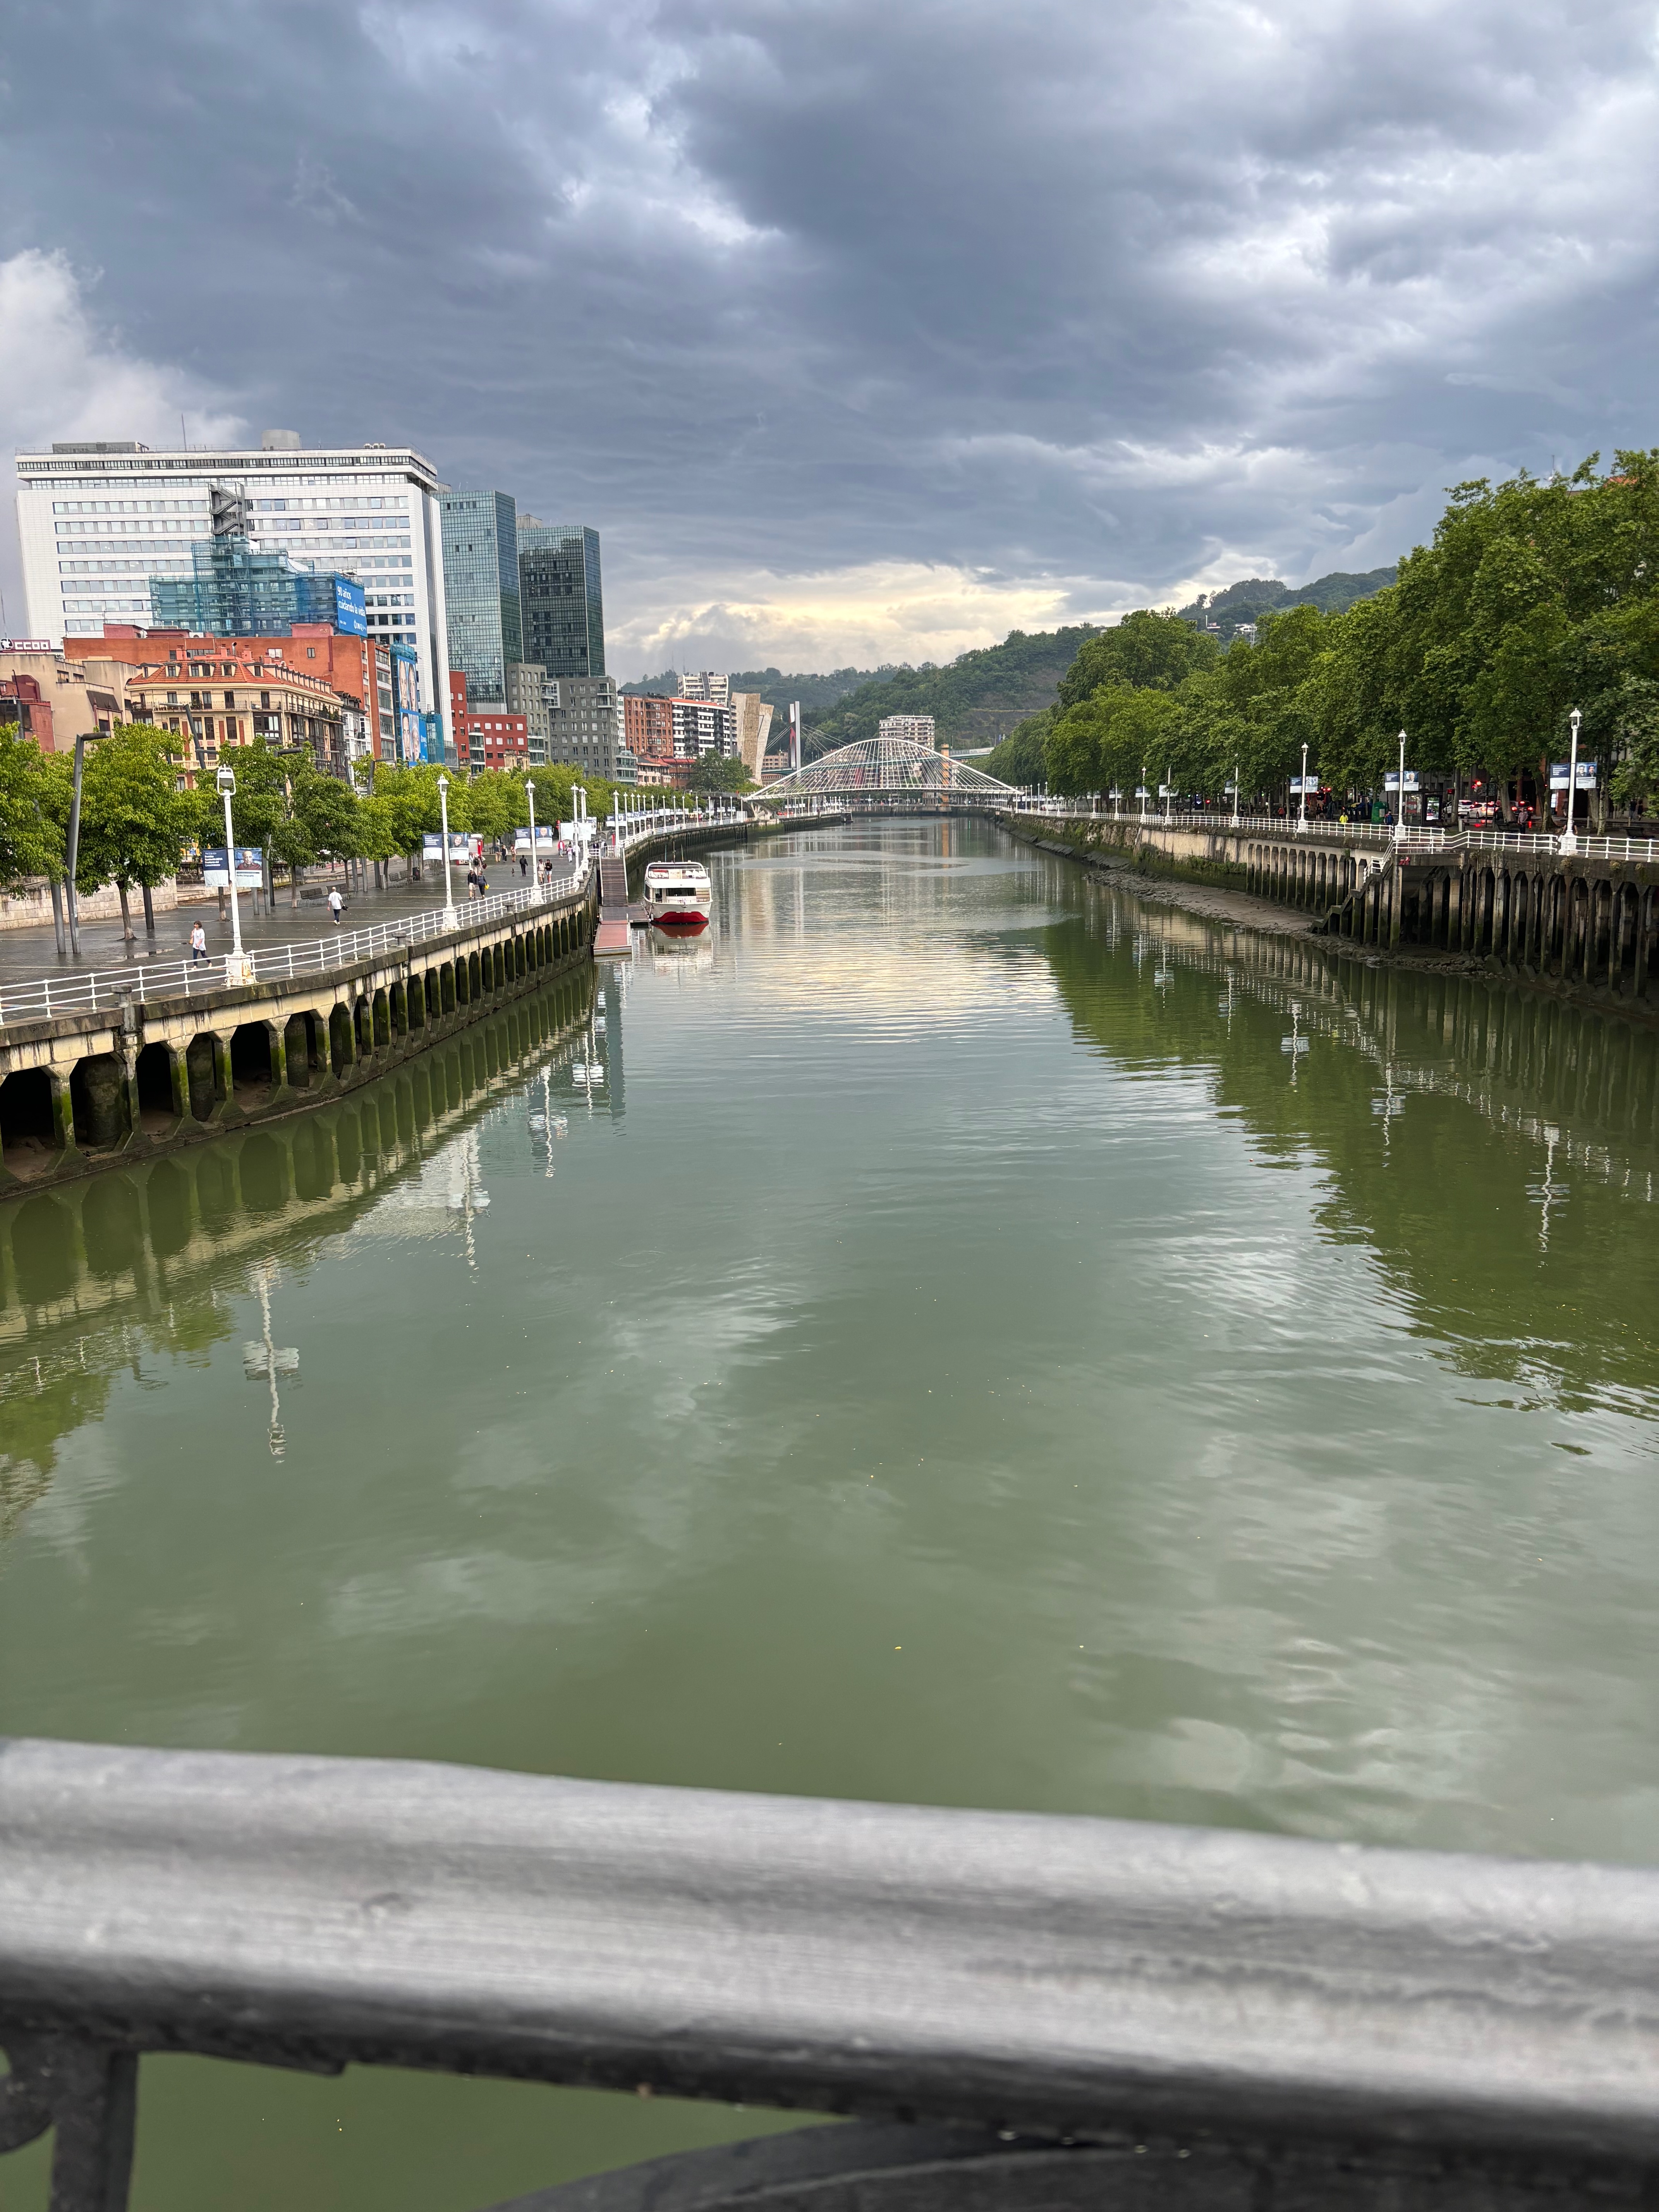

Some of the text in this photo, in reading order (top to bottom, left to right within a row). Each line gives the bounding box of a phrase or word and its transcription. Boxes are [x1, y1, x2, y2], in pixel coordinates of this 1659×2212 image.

[337, 586, 351, 600] 90 años
[338, 599, 354, 613] cuidando
[354, 603, 358, 615] la
[14, 642, 49, 650] CCOO
